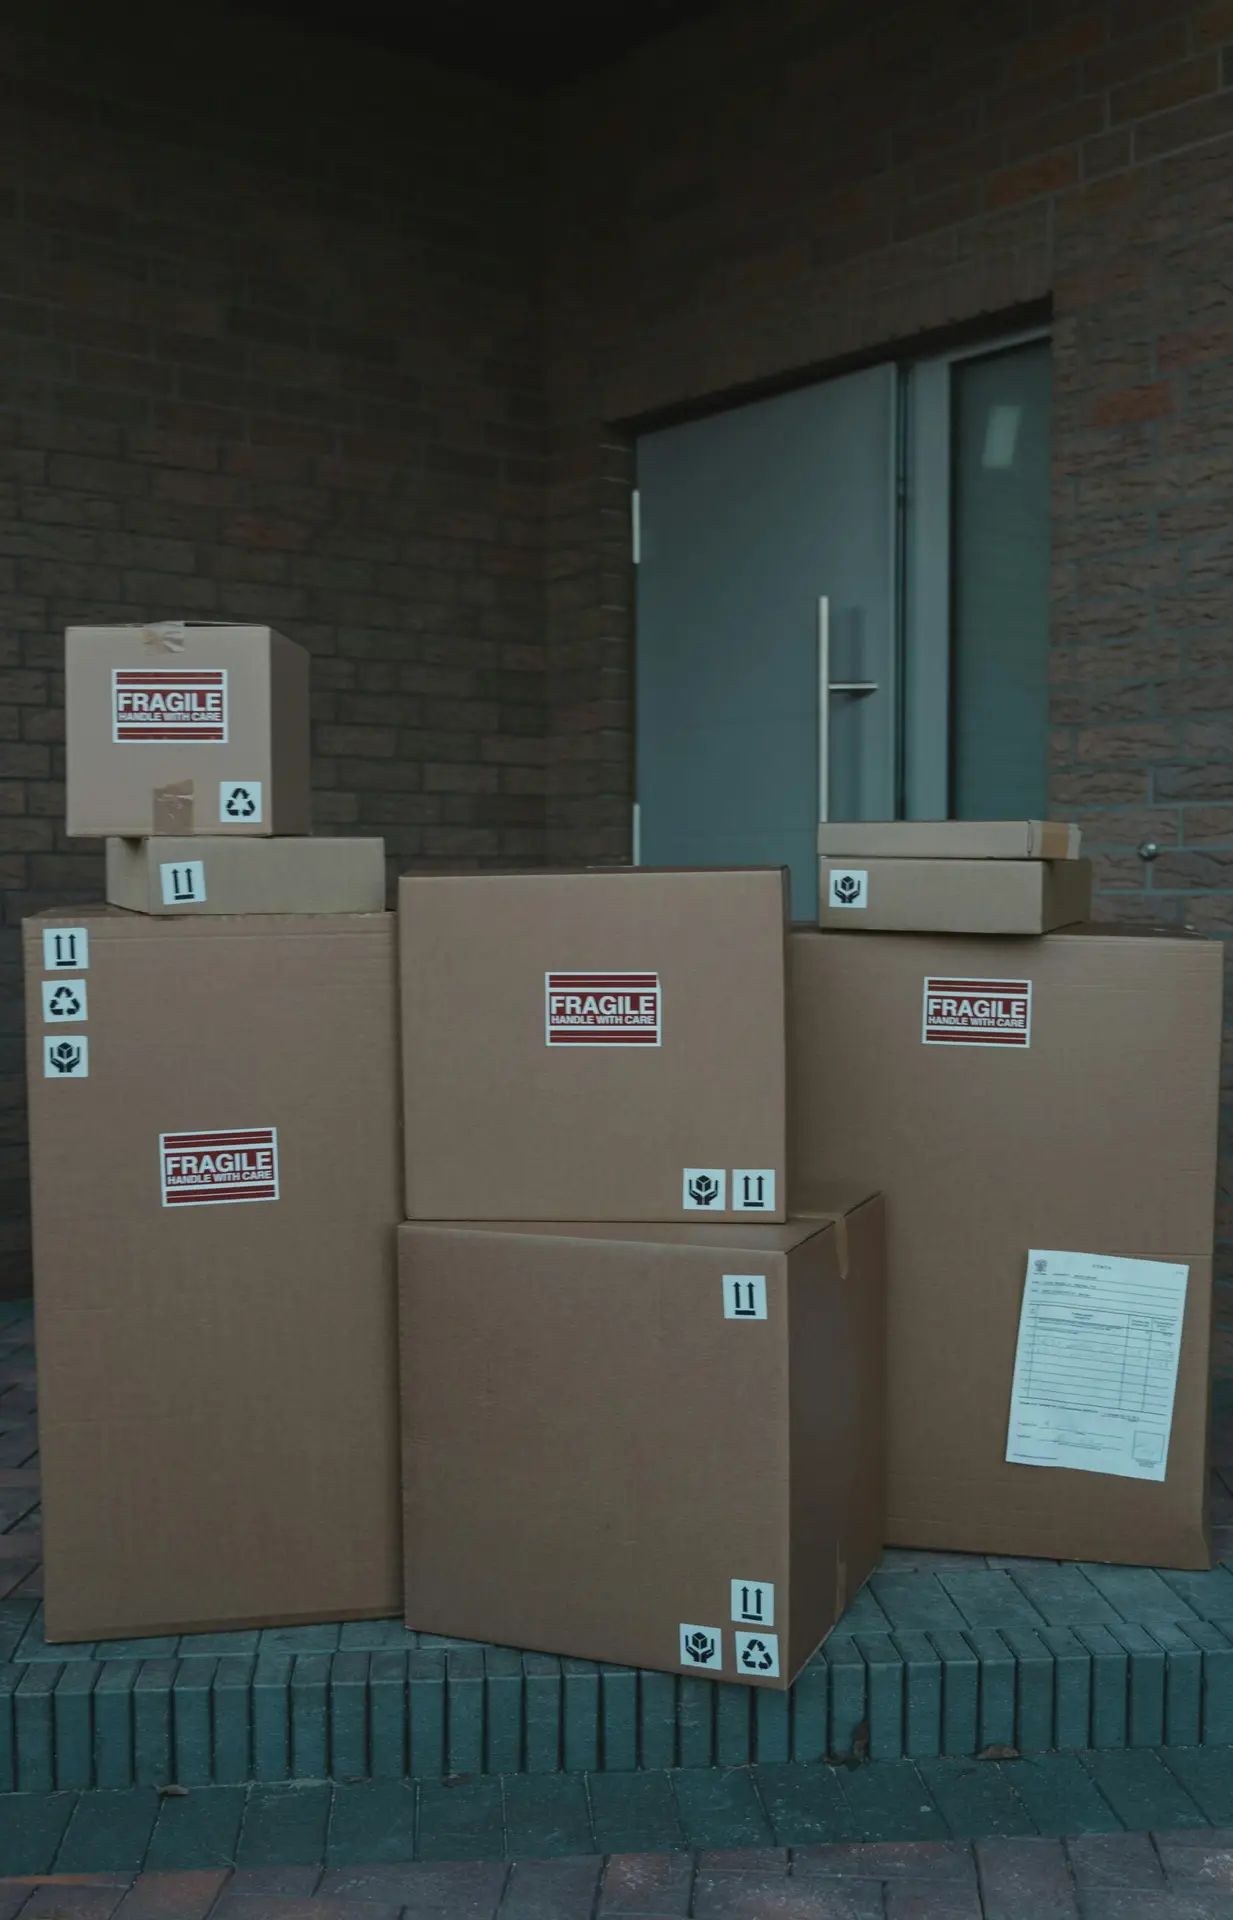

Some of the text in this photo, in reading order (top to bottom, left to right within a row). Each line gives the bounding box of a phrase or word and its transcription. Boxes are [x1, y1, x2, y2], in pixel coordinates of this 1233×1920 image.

[118, 692, 221, 712] FRAGILE
[191, 712, 221, 721] CARE
[551, 996, 655, 1015] FRAGILE
[928, 998, 1025, 1018] FRAGILE
[551, 1015, 655, 1024] HANDLE WITH CARE
[928, 1016, 1025, 1027] HANDLE WITH CARE
[166, 1151, 272, 1175] FRAGILE
[167, 1170, 272, 1185] HANDLE WITH CARE
